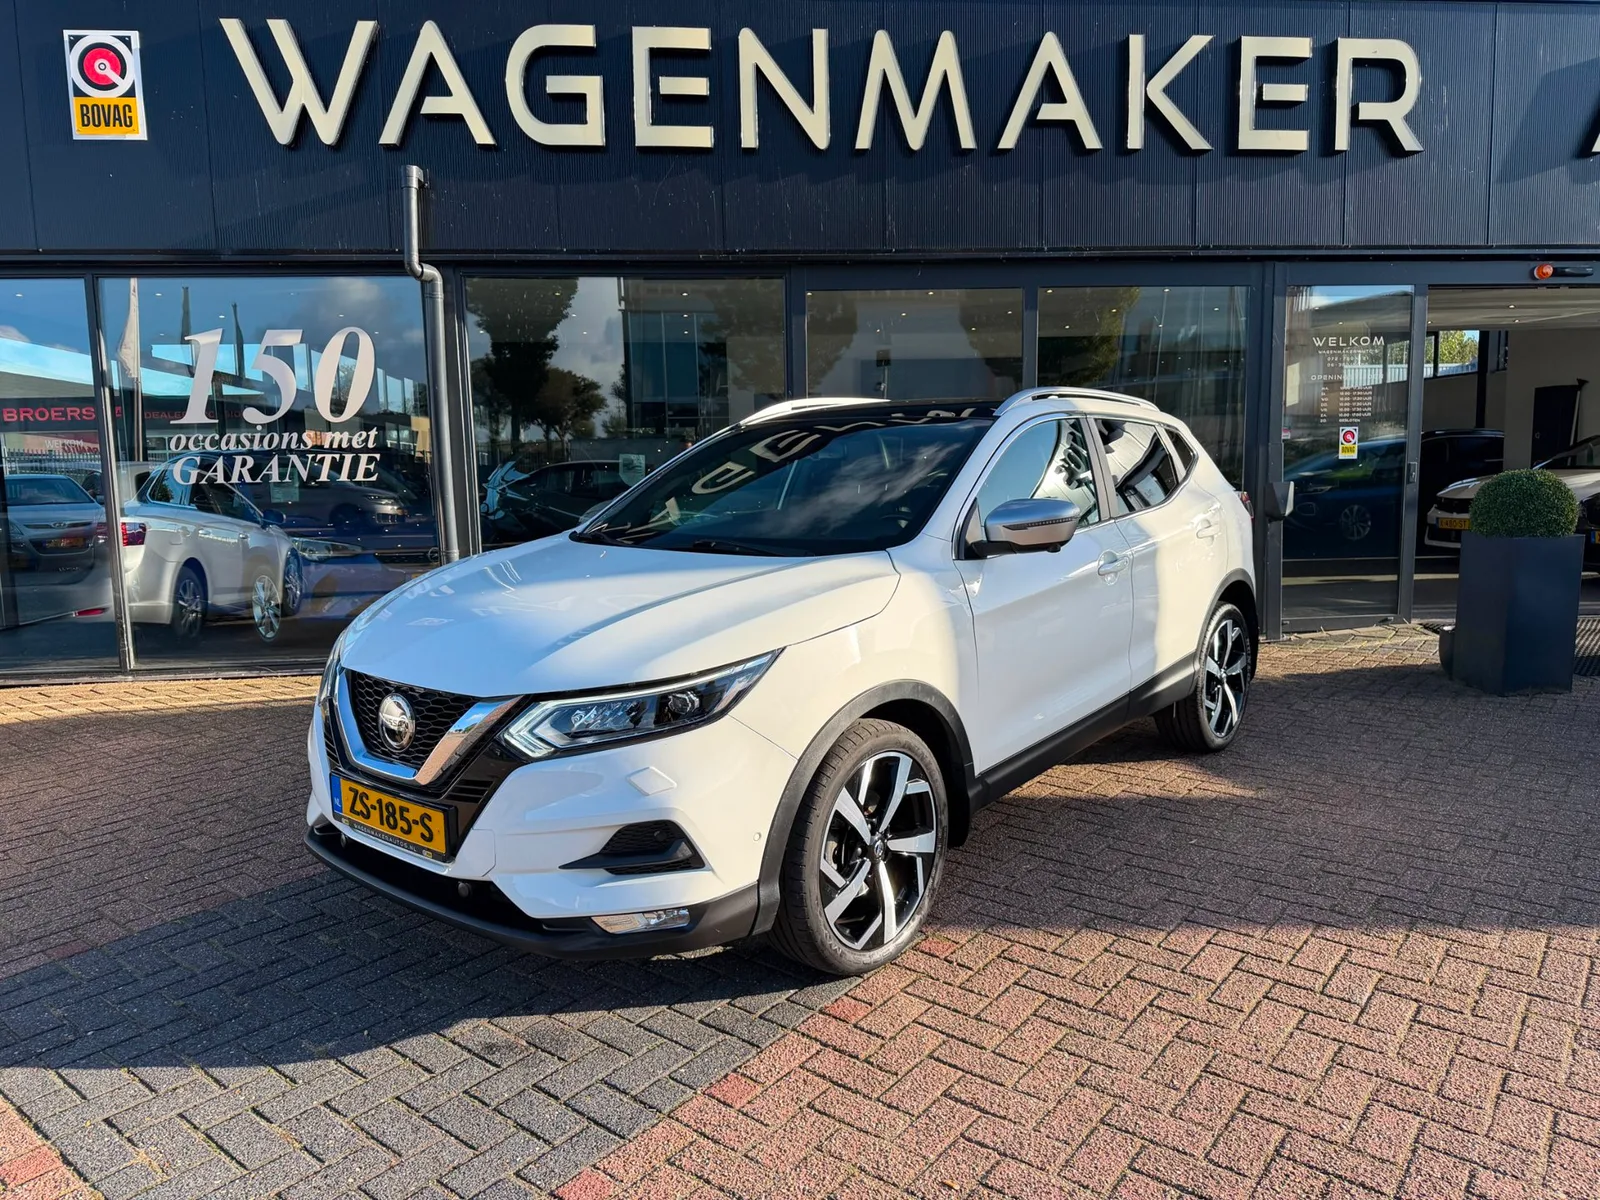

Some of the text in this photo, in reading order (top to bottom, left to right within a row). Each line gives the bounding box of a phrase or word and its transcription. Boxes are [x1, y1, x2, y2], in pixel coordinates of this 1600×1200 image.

[219, 17, 1424, 153] WAGENMAKER
[80, 103, 133, 128] BOVAG
[1312, 336, 1385, 347] WELKOM
[170, 326, 376, 424] 150
[2, 406, 96, 422] BROERS
[169, 425, 379, 451] occasions met
[172, 453, 381, 485] GARANTIE
[348, 786, 434, 843] ZS-185-S
